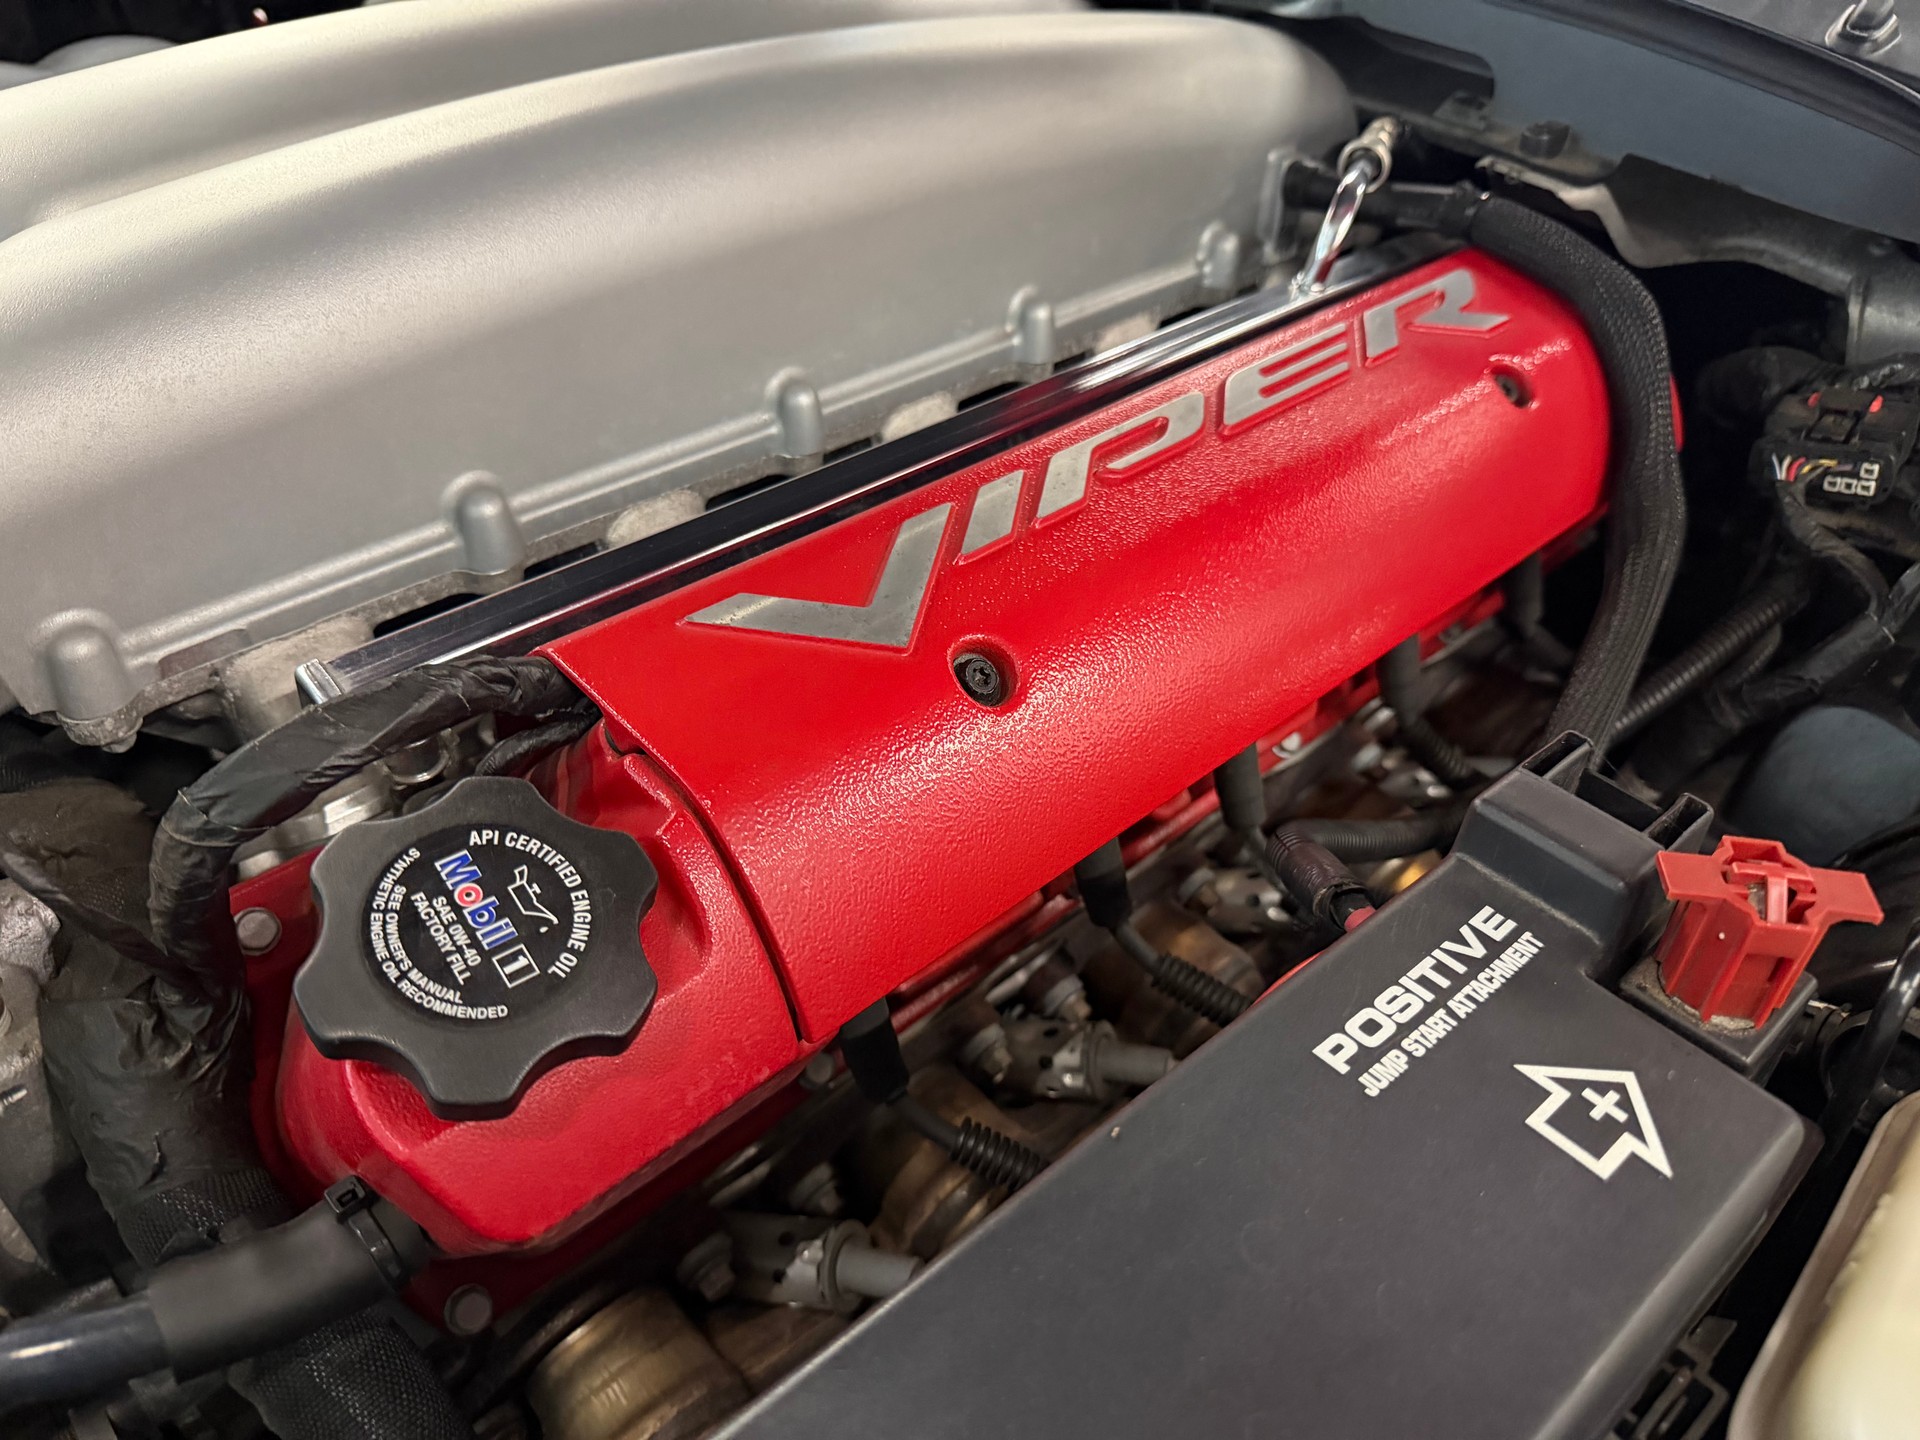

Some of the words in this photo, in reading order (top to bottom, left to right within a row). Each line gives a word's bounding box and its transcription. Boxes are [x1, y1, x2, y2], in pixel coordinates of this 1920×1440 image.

[684, 267, 1511, 649] VIPER
[469, 829, 500, 847] API
[504, 831, 582, 888] CERTIFIED
[372, 846, 421, 911] SYNTHETIC
[387, 883, 407, 911] SEE
[434, 849, 519, 951] Mobil
[369, 911, 390, 962] ENGINE
[385, 911, 413, 972] OWNER'S
[410, 891, 457, 953] FACTORY
[446, 952, 472, 986] FILL
[432, 895, 458, 925] SAE
[448, 923, 482, 967] 0W-40
[567, 889, 592, 952] ENGINE
[381, 960, 402, 984] OIL
[406, 967, 464, 1005] MANUAL
[547, 951, 578, 979] OIL
[1311, 904, 1519, 1075] POSITIVE
[396, 978, 509, 1020] RECOMMENDED
[1357, 1049, 1410, 1098] JUMP
[1401, 1007, 1458, 1058] START
[1446, 931, 1546, 1020] ATTACHMENT
